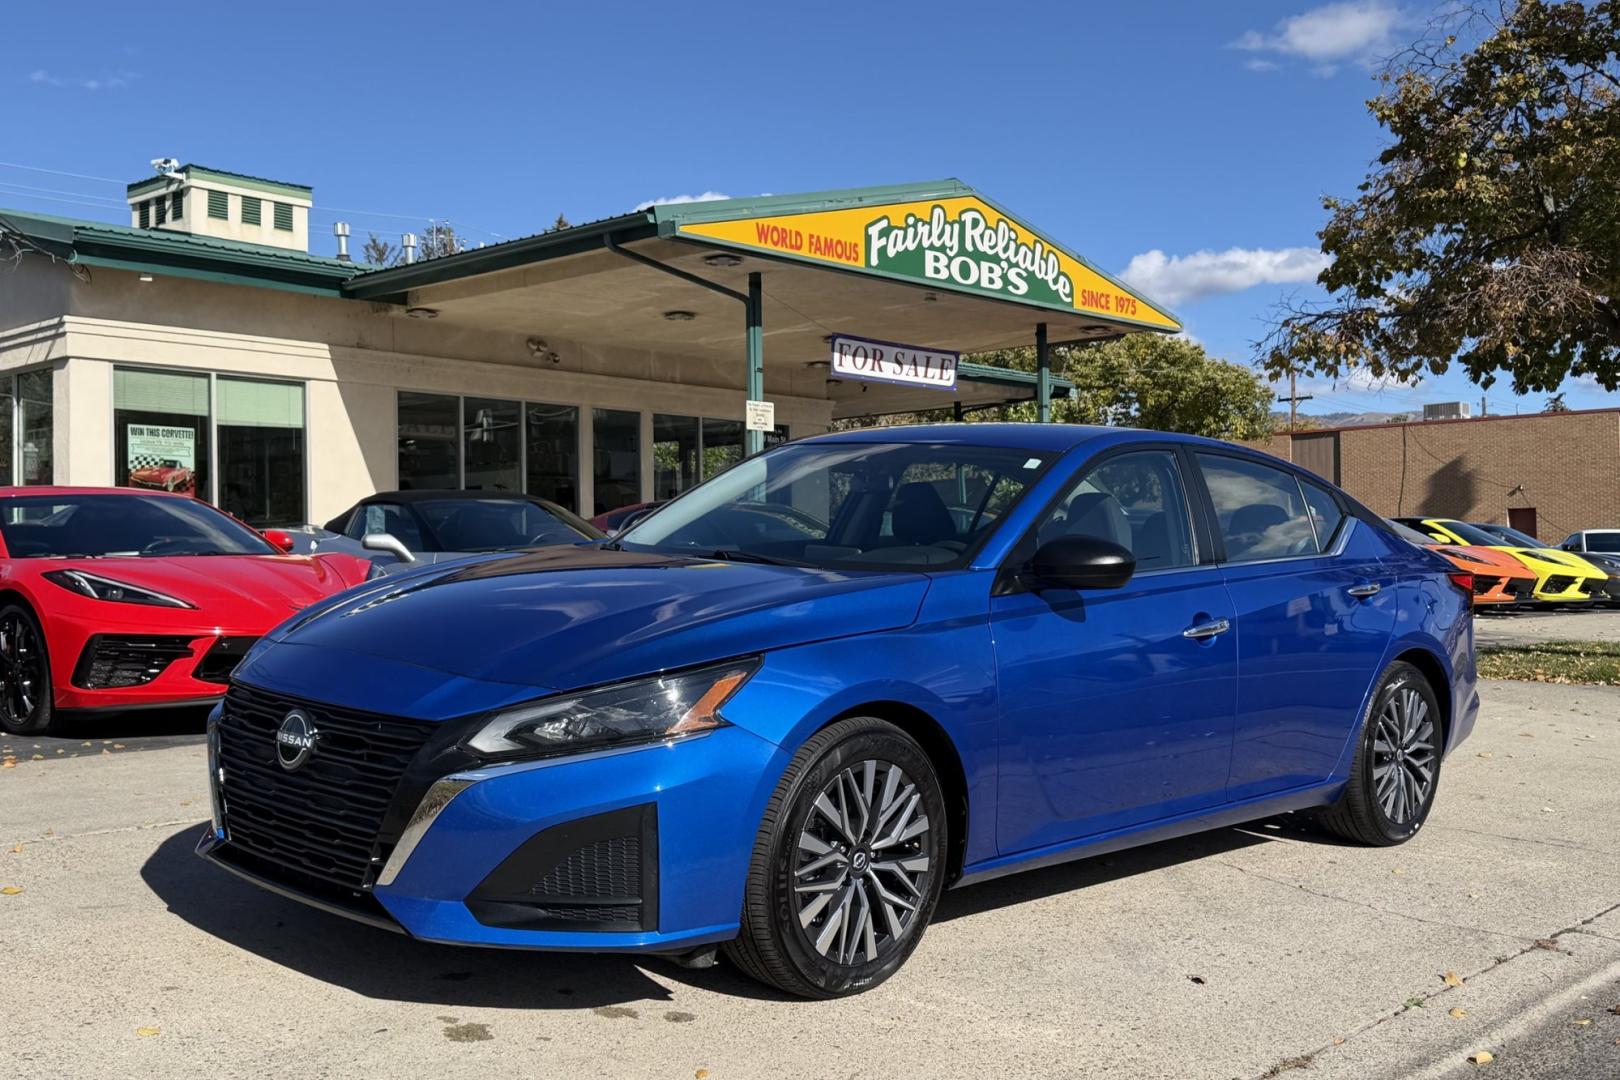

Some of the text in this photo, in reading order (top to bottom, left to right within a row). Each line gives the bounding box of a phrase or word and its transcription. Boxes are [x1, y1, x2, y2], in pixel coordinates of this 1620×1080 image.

[755, 222, 859, 262] WORLD FAMOUS
[868, 206, 1072, 302] Fairly Reliable
[925, 249, 1029, 295] BOB'S
[1081, 288, 1137, 315] SINCE 1975
[838, 342, 953, 382] FOR SALE
[130, 426, 144, 436] WIN
[146, 427, 160, 437] THIS
